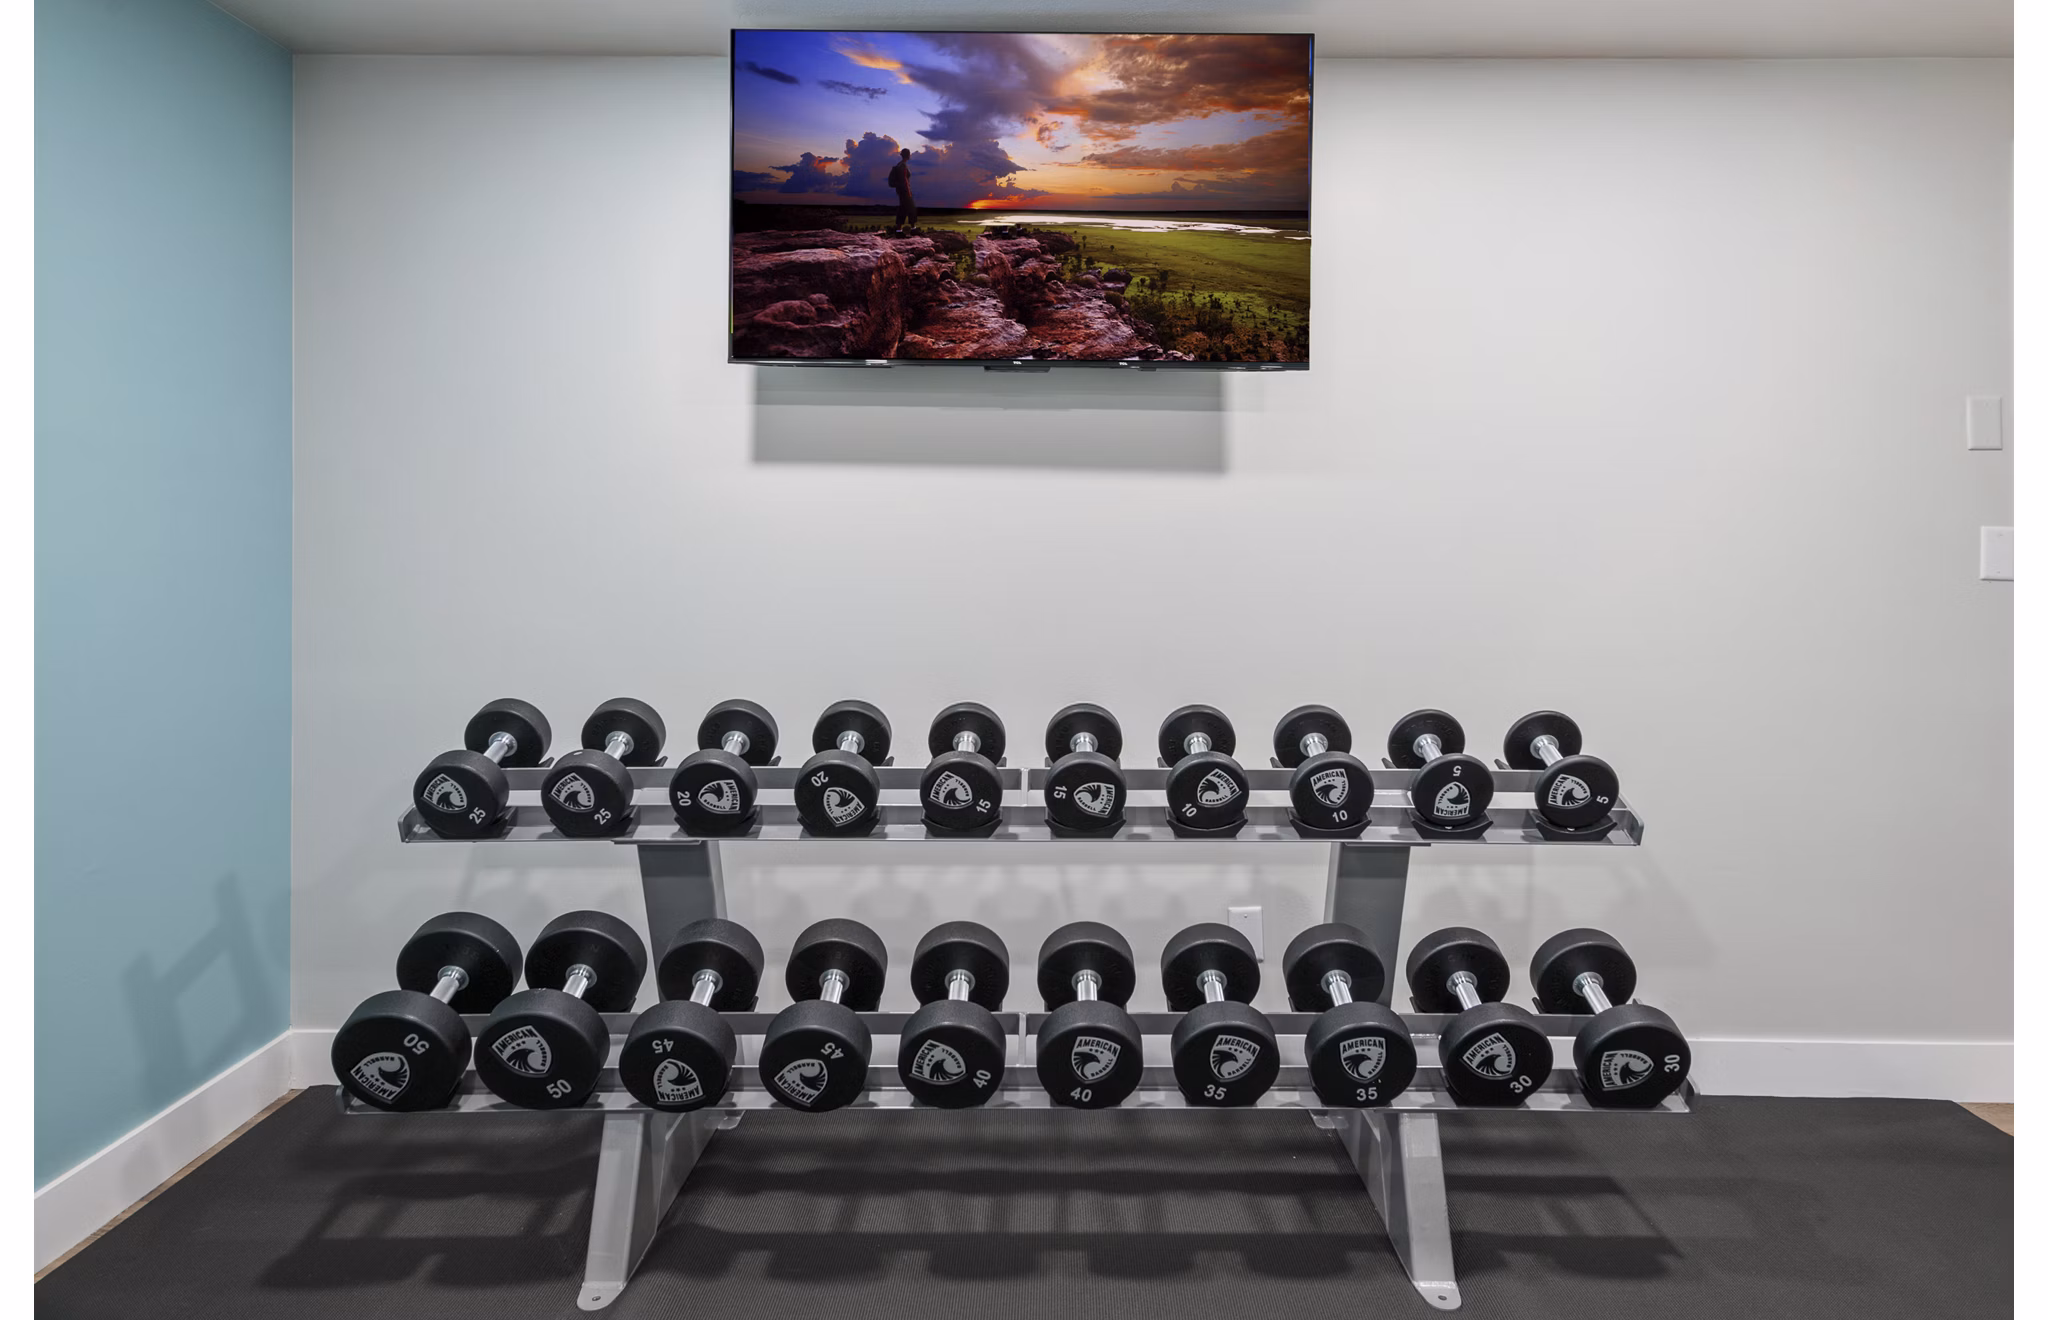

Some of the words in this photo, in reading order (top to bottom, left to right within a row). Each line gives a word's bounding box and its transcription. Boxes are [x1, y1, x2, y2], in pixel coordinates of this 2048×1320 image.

[811, 771, 829, 787] 20
[1312, 769, 1345, 786] AMERICAN
[1453, 765, 1462, 777] 5
[425, 774, 448, 798] AMERICAN
[552, 773, 580, 796] AMERICAN
[931, 772, 954, 800] AMERICAN
[1053, 785, 1068, 799] 15
[1211, 770, 1239, 797] AMERICAN
[1550, 775, 1570, 803] AMERICAN
[677, 791, 691, 806] 20
[728, 780, 740, 810] AMERICAN
[1101, 785, 1115, 814] AMERICAN
[1596, 795, 1609, 804] 5
[833, 803, 864, 823] AMERICAN
[976, 799, 991, 813] 15
[1181, 803, 1197, 817] 10
[1435, 805, 1469, 816] AMERICAN
[469, 807, 486, 824] 25
[594, 808, 611, 825] 25
[1332, 810, 1348, 823] 10
[404, 1033, 429, 1055] 50
[494, 1028, 536, 1055] AMERICAN
[652, 1038, 674, 1054] 45
[820, 1042, 844, 1059] 45
[1078, 1038, 1119, 1056] AMERICAN
[1216, 1037, 1258, 1057] AMERICAN
[1342, 1038, 1384, 1055] AMERICAN
[1465, 1034, 1505, 1063] AMERICAN
[914, 1042, 938, 1073] AMERICAN
[1664, 1054, 1680, 1073] 30
[1603, 1052, 1616, 1087] AMERICAN
[353, 1068, 397, 1097] AMERICAN
[777, 1074, 818, 1101] AMERICAN
[973, 1070, 991, 1088] 40
[1510, 1075, 1532, 1093] 30
[546, 1079, 572, 1099] 50
[659, 1087, 701, 1101] AMERICAN
[1070, 1087, 1092, 1102] 40
[1204, 1084, 1227, 1100] 35
[1356, 1087, 1378, 1101] 35
